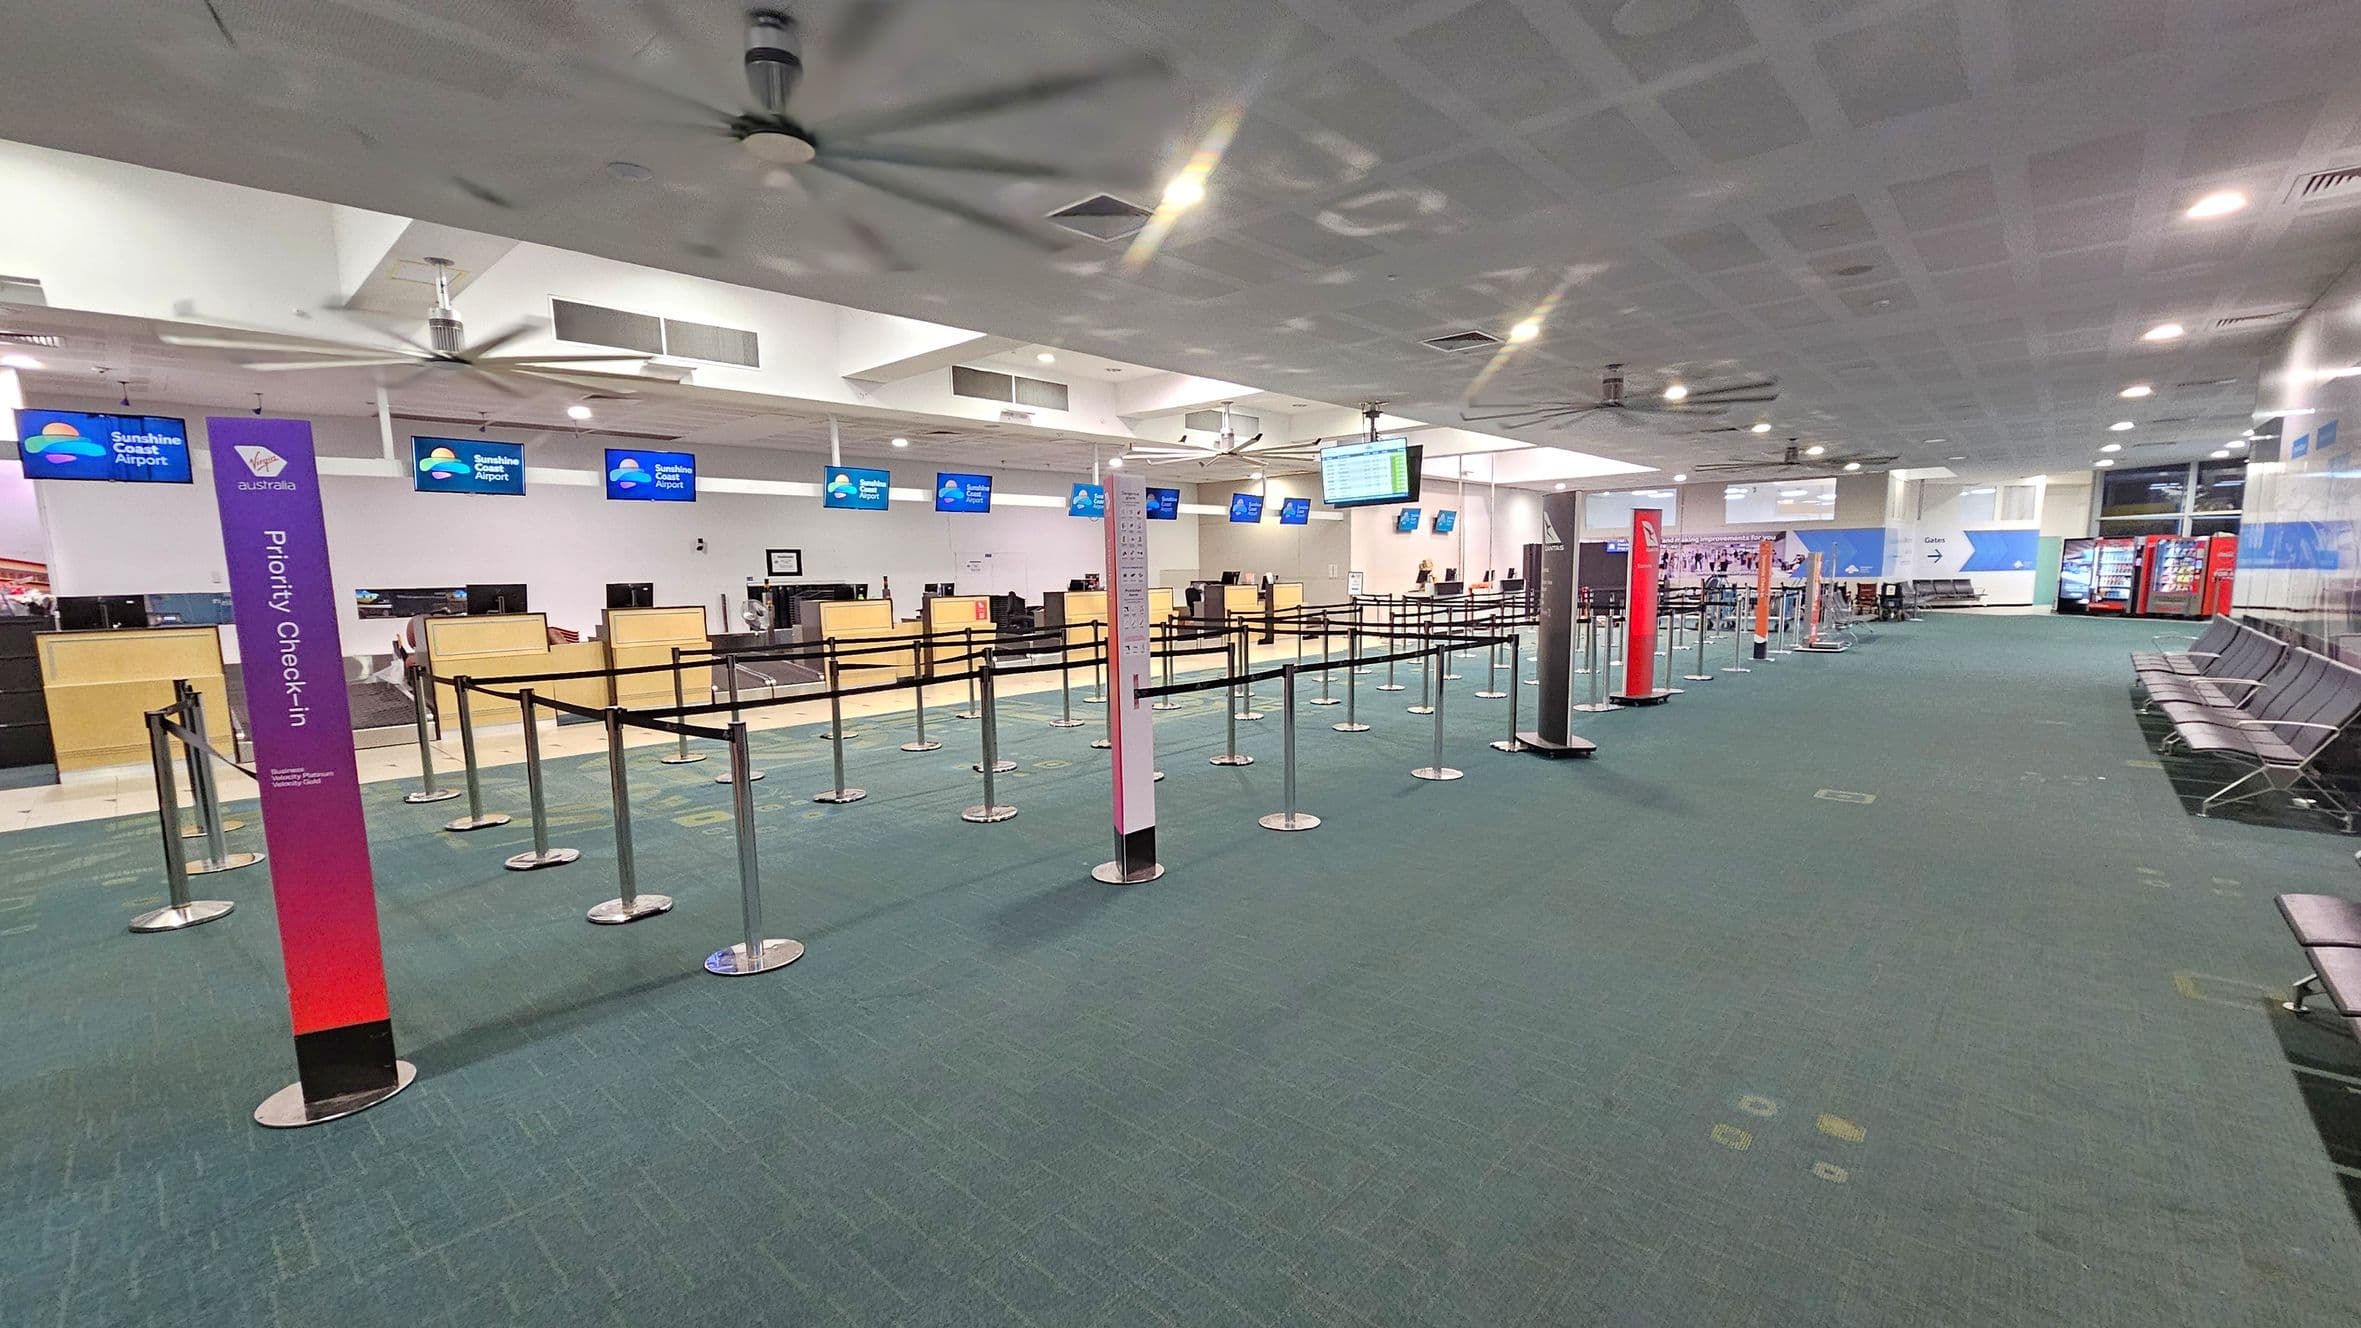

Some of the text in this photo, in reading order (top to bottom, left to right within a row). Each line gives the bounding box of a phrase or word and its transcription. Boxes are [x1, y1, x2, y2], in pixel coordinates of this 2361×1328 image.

[111, 431, 182, 446] Sunshine
[113, 443, 160, 455] Coast
[115, 454, 169, 467] Airport
[250, 451, 279, 472] Virgin
[473, 454, 520, 466] Sunshine
[474, 463, 505, 473] Coast
[654, 464, 693, 474] Sunshine
[475, 472, 509, 482] Airport
[655, 472, 680, 481] Coast
[238, 480, 297, 491] australia
[655, 480, 684, 490] Airport
[859, 492, 880, 500] Airport
[1700, 533, 1749, 544] improvements
[1924, 536, 1946, 544] Gates
[264, 530, 310, 727] Priority Check-in
